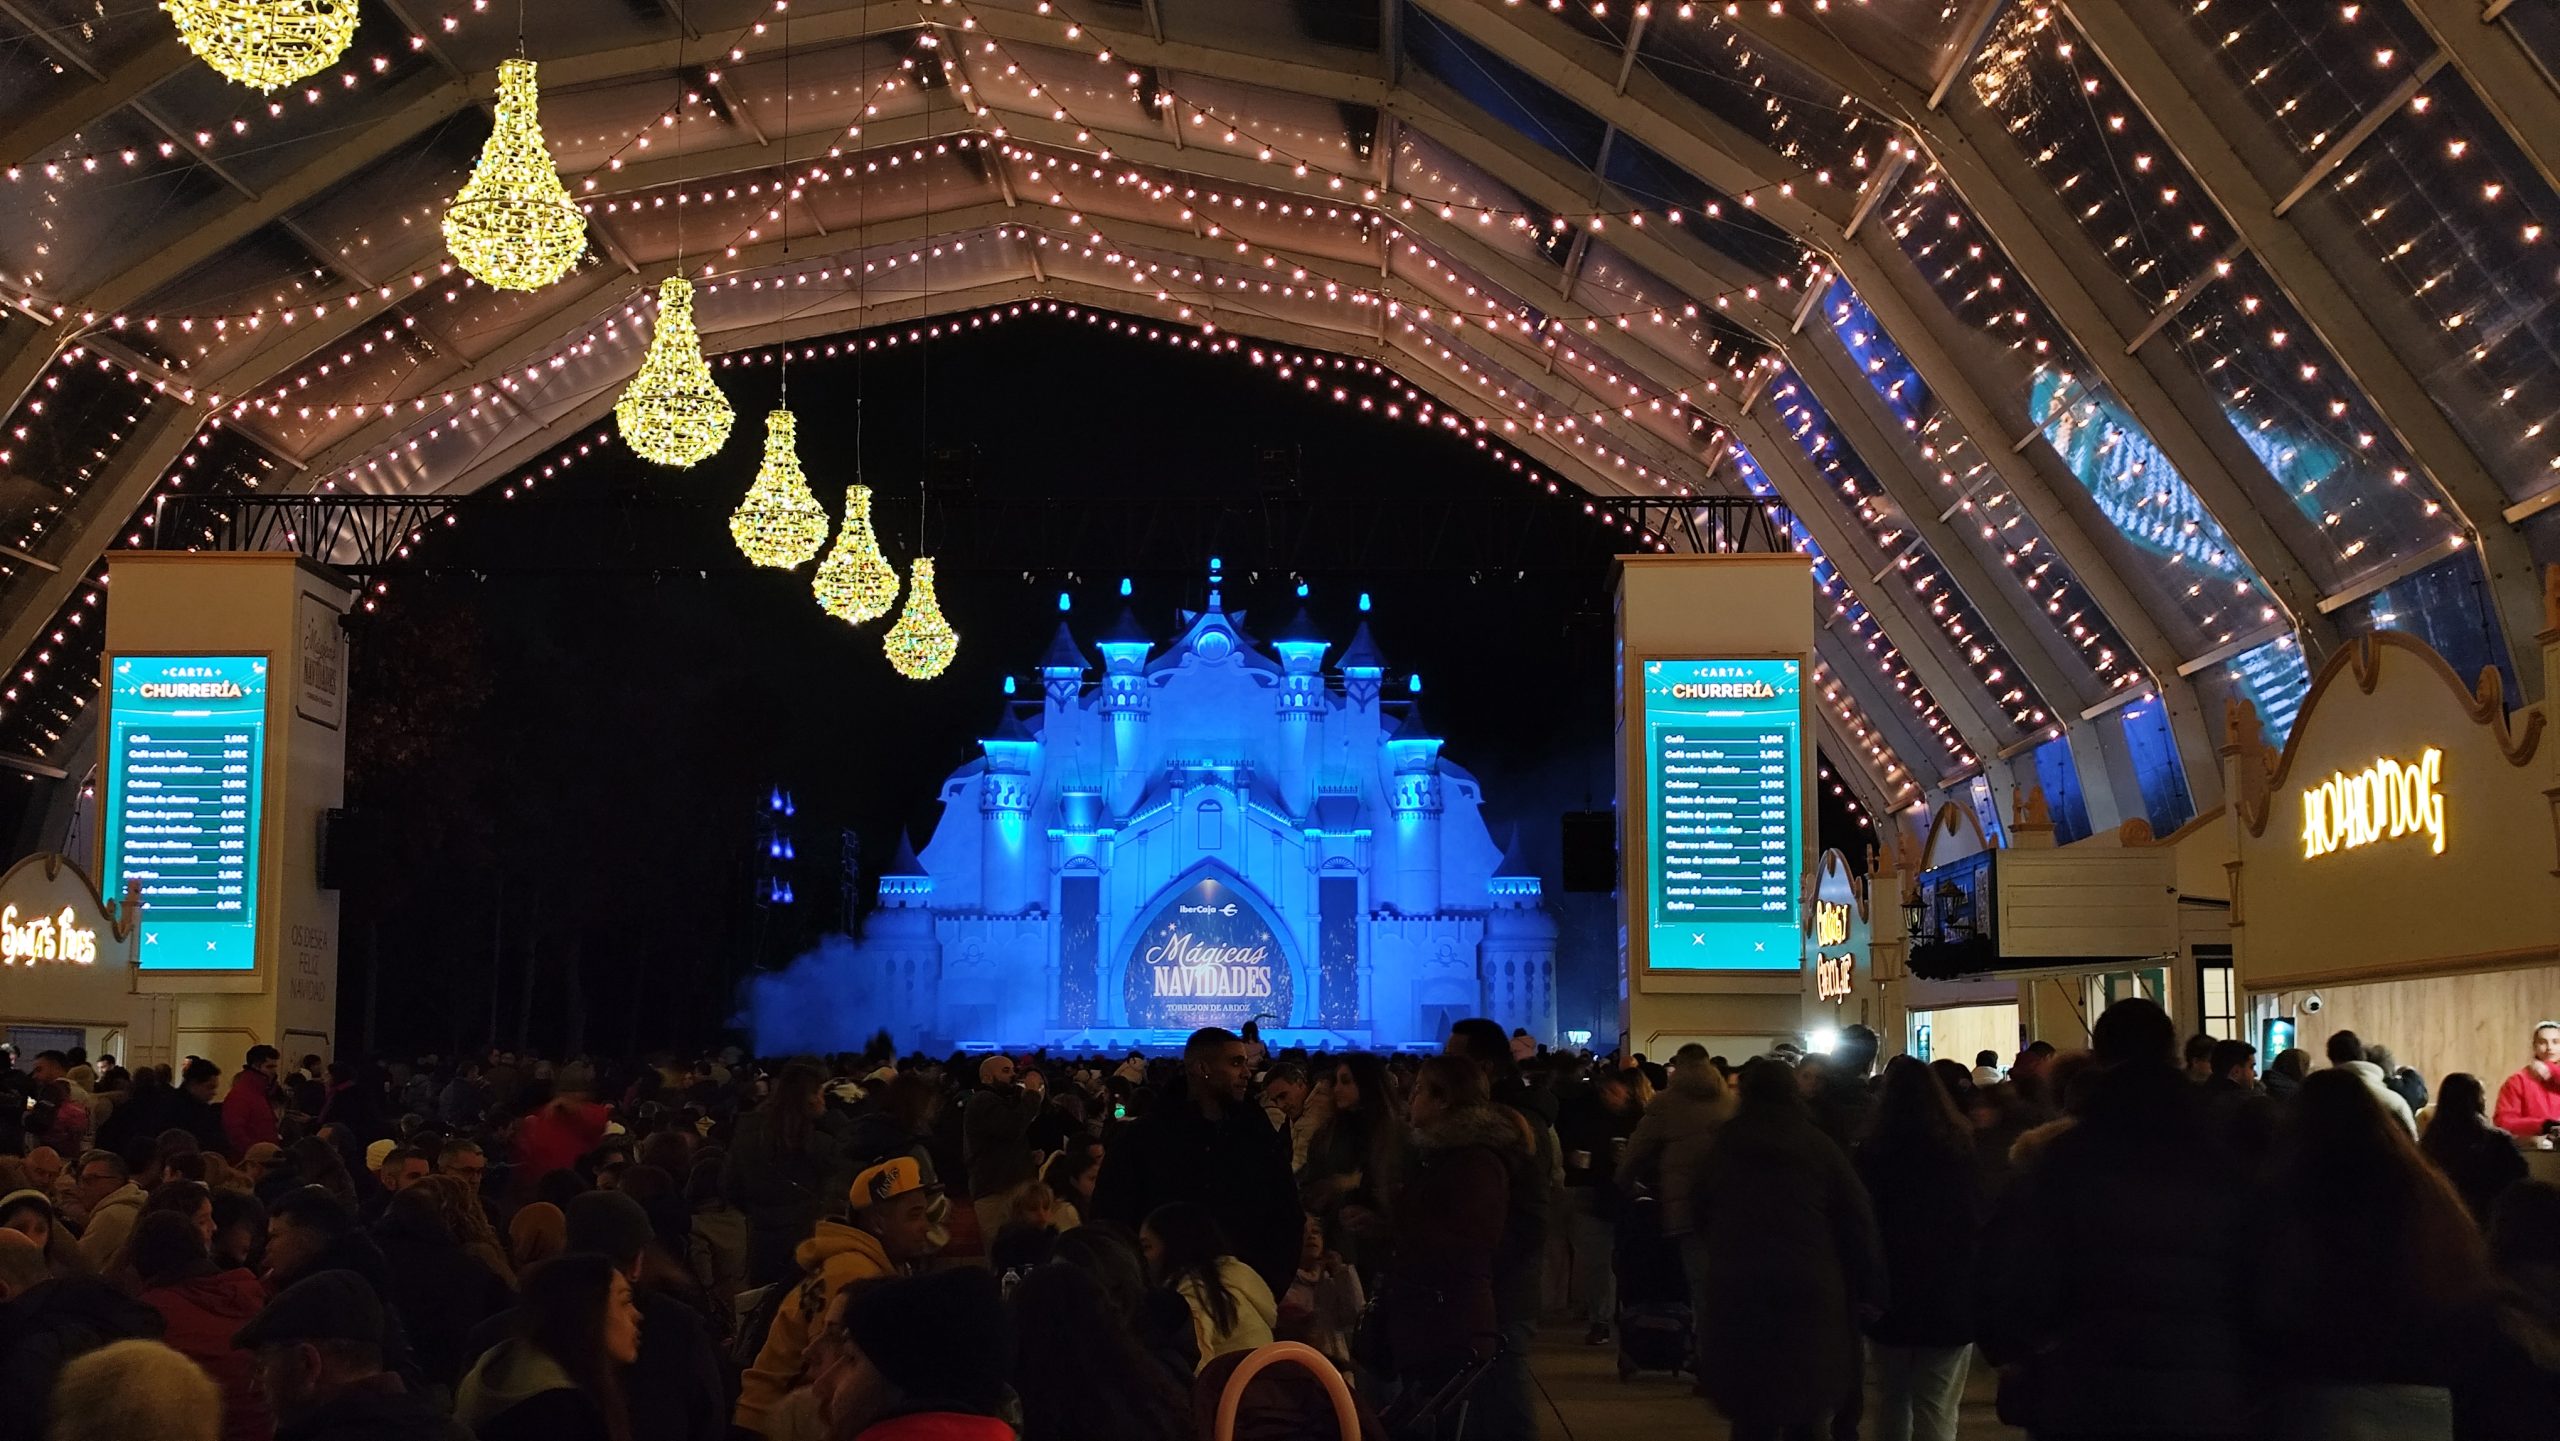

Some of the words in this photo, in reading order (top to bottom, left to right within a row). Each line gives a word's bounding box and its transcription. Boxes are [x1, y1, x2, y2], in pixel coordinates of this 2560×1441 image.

[168, 667, 213, 677] CARTA
[1700, 667, 1744, 677] CARTA
[140, 680, 242, 698] CHURRERÍA
[1672, 679, 1775, 698] CHURRERÍA
[1692, 856, 1703, 864] de
[1145, 932, 1269, 968] Mágicas
[1153, 965, 1271, 997] NAVIDADES
[1567, 1030, 1592, 1046] VIP
